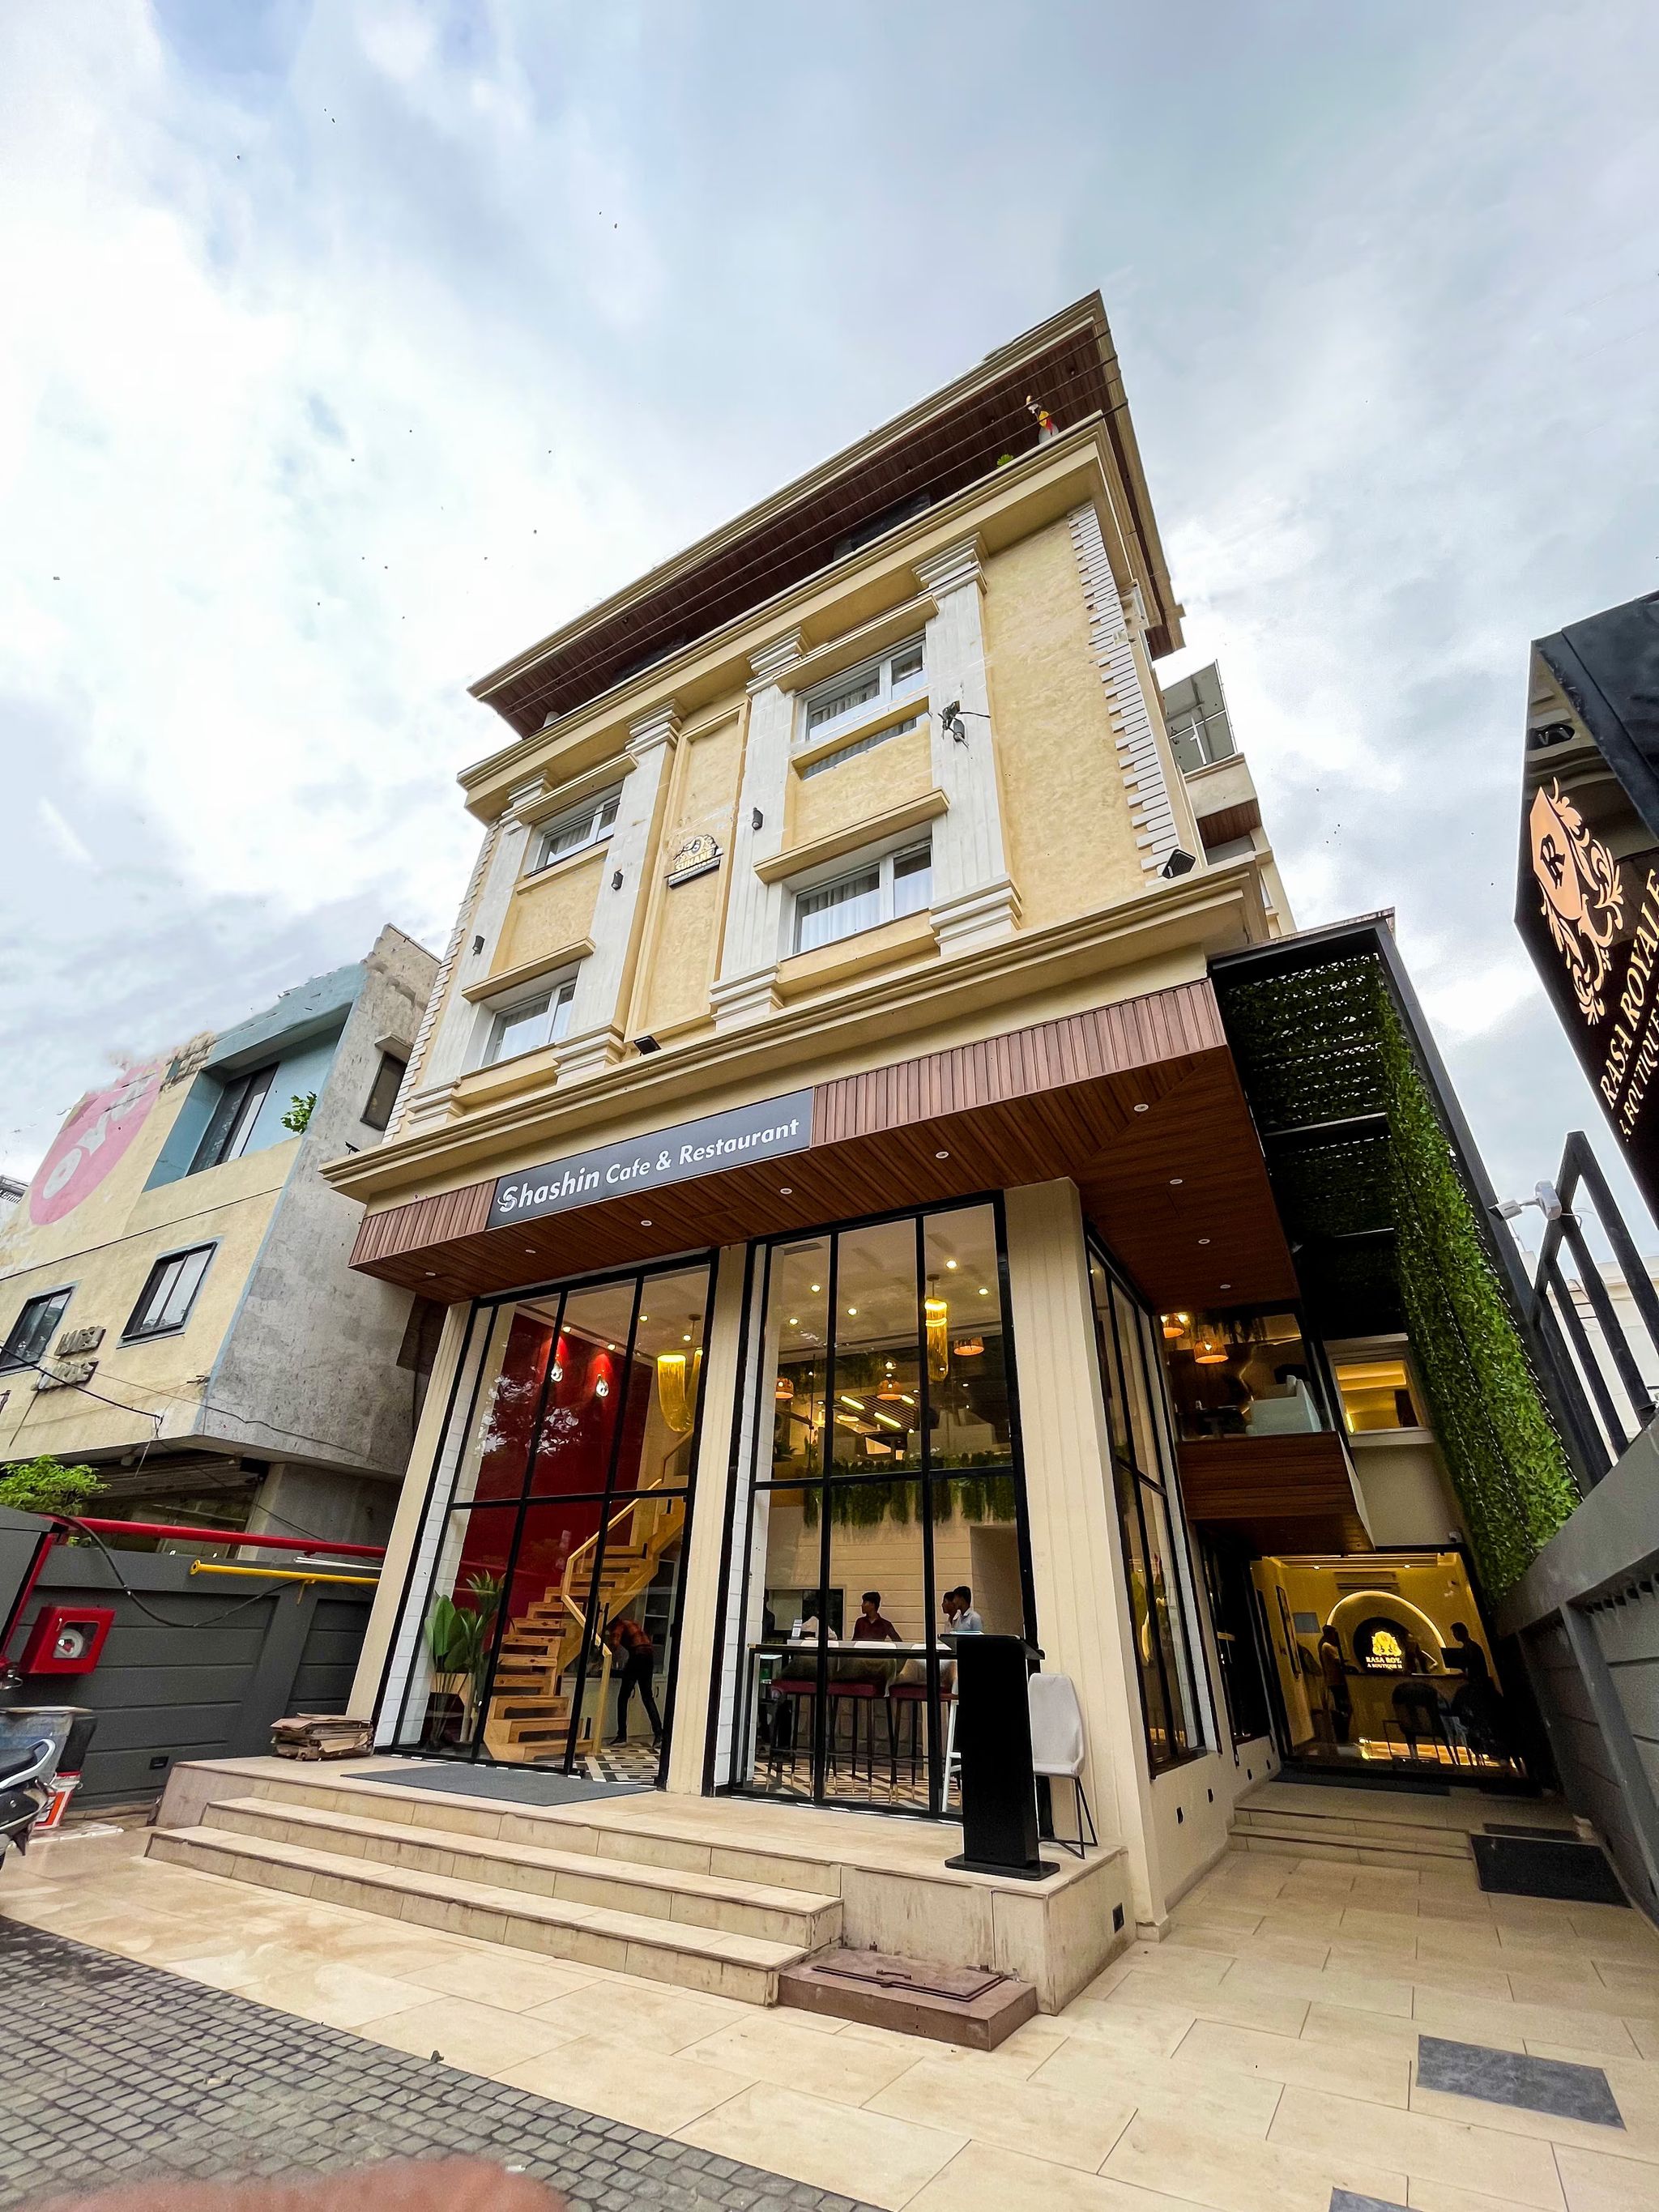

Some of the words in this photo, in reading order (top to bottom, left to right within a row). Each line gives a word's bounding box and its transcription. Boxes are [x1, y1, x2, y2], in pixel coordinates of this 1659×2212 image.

[1540, 833, 1565, 889] R
[1601, 1024, 1632, 1110] RASA
[497, 1167, 600, 1213] Shashin
[605, 1157, 651, 1184] Cafe
[655, 1150, 672, 1172] &
[678, 1119, 800, 1166] Restaurant
